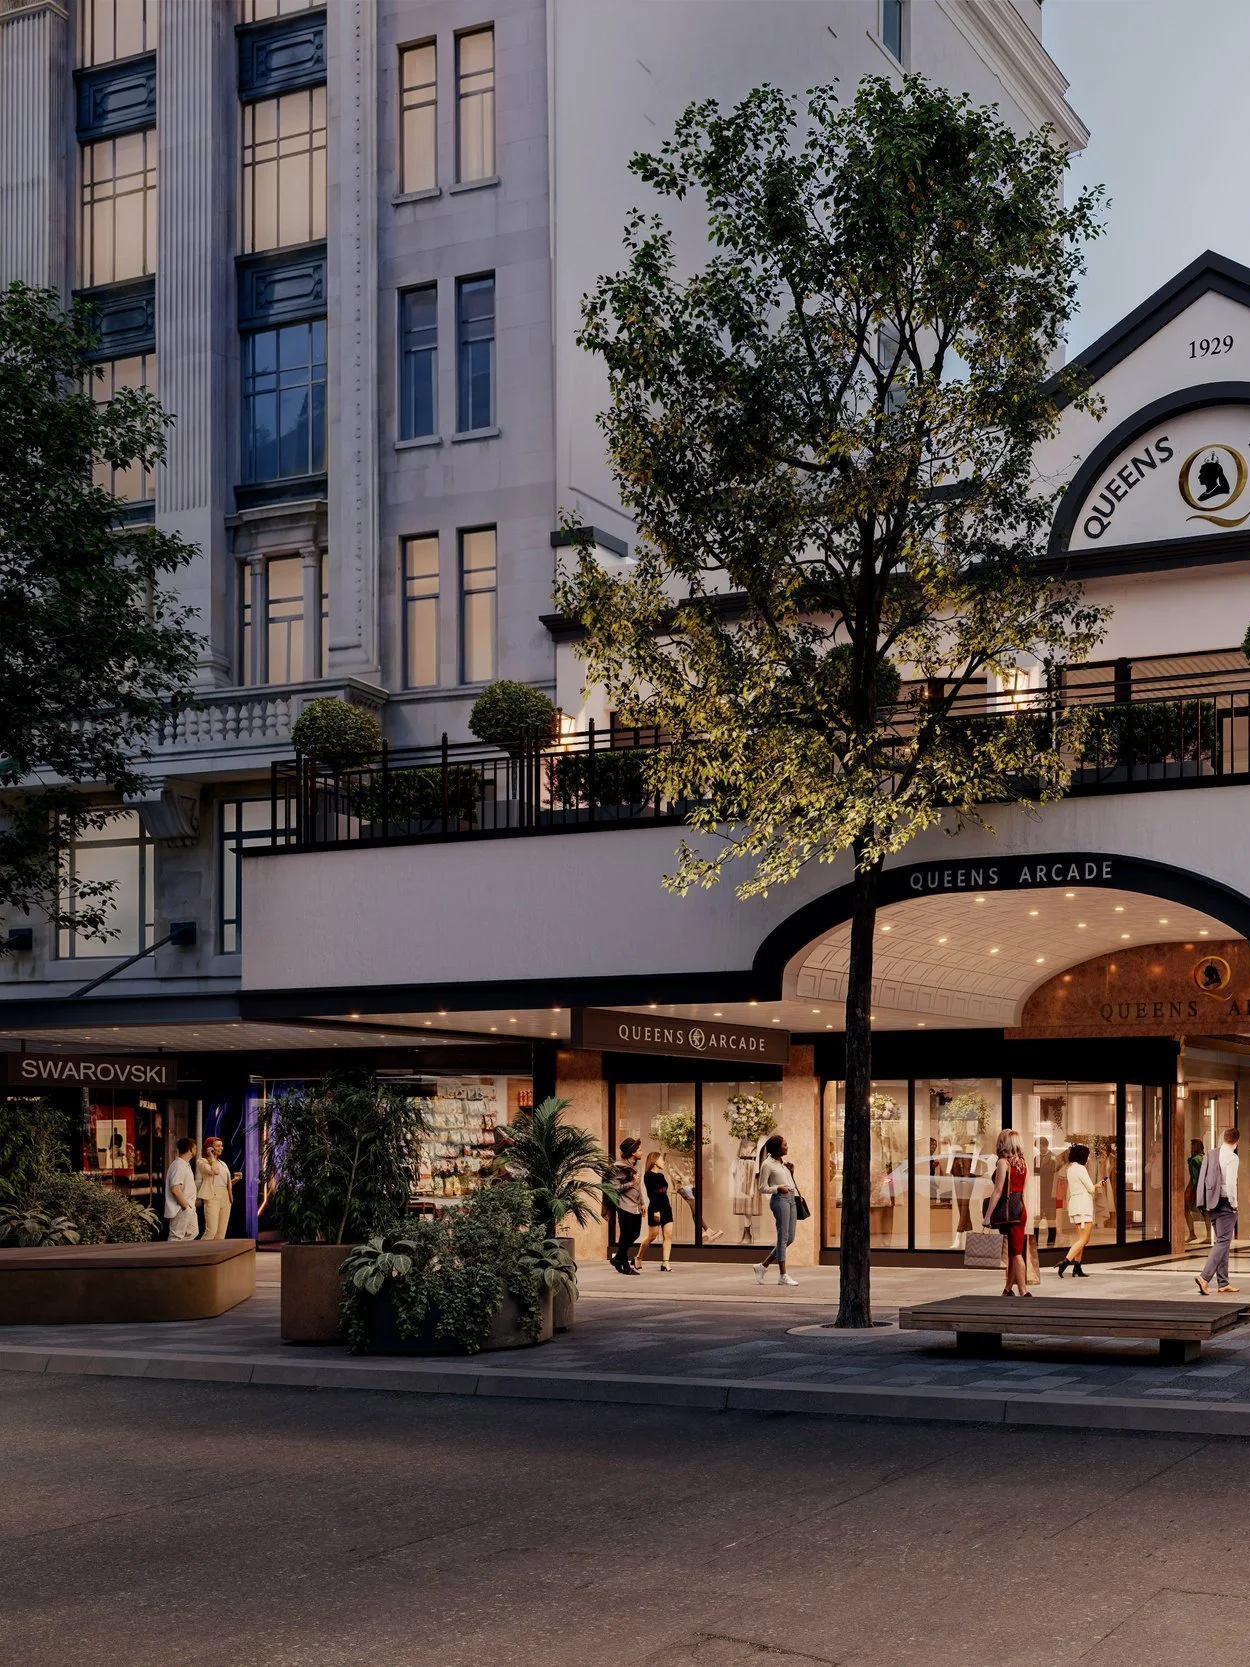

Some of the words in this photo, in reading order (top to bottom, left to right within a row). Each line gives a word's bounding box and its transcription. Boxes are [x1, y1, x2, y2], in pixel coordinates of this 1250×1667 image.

[1188, 335, 1234, 359] 1929
[1083, 436, 1174, 539] QUEENS
[910, 867, 999, 890] QUEENS
[1019, 861, 1112, 883] ARCADE
[1100, 1001, 1198, 1022] QUEENS
[618, 1024, 684, 1045] QUEENS
[709, 1033, 765, 1051] ARCADE
[21, 1060, 167, 1083] SWAROVSKI
